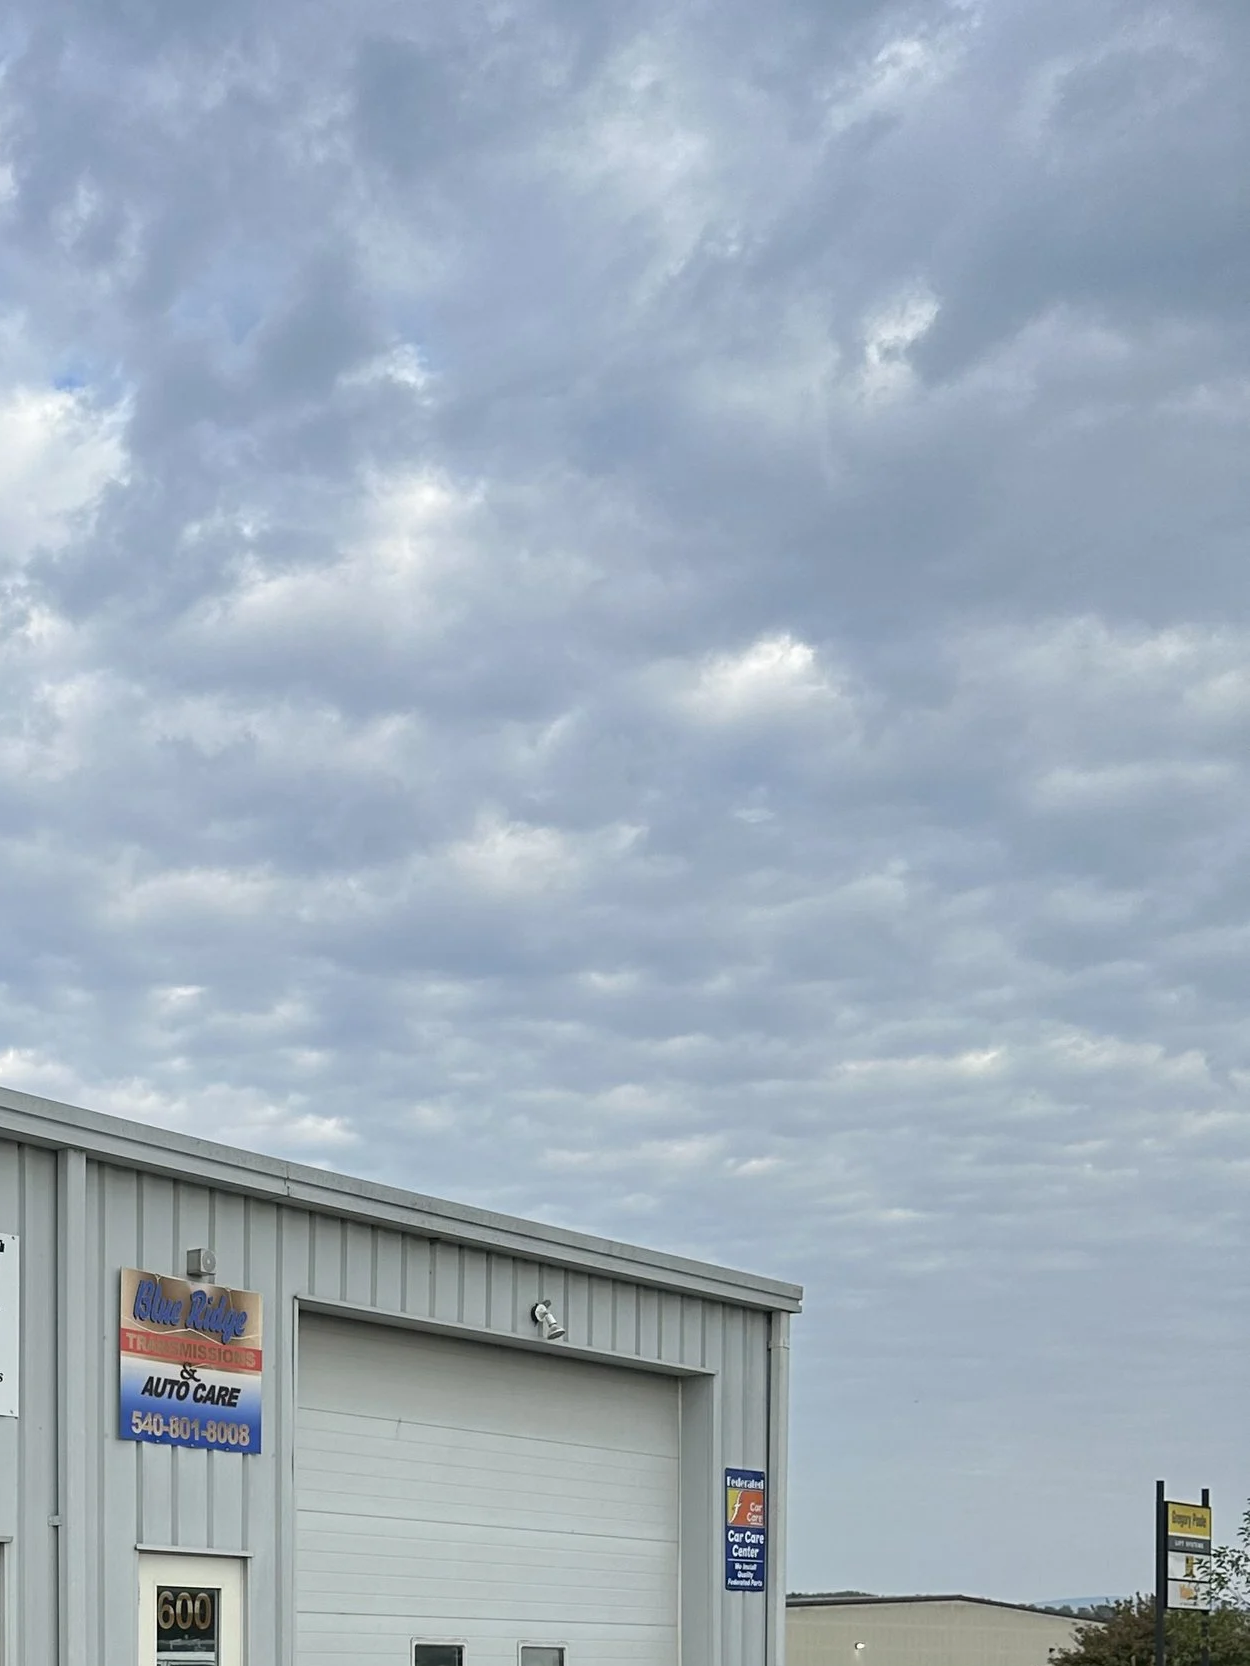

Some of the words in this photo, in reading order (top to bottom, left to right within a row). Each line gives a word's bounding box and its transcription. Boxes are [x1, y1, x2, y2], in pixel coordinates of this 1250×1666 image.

[133, 1280, 184, 1327] Blue
[185, 1290, 248, 1345] Ridge
[126, 1332, 256, 1368] TRANSMISSIONS
[180, 1362, 201, 1382] &
[141, 1376, 190, 1400] AUTO
[193, 1383, 242, 1408] CARE
[132, 1410, 250, 1446] 540-801-8008
[726, 1476, 764, 1490] Federated
[750, 1502, 763, 1512] Car
[746, 1512, 763, 1523] Care
[728, 1530, 744, 1542] Car
[745, 1531, 764, 1544] Care
[732, 1544, 759, 1558] Center
[158, 1590, 211, 1630] 600
